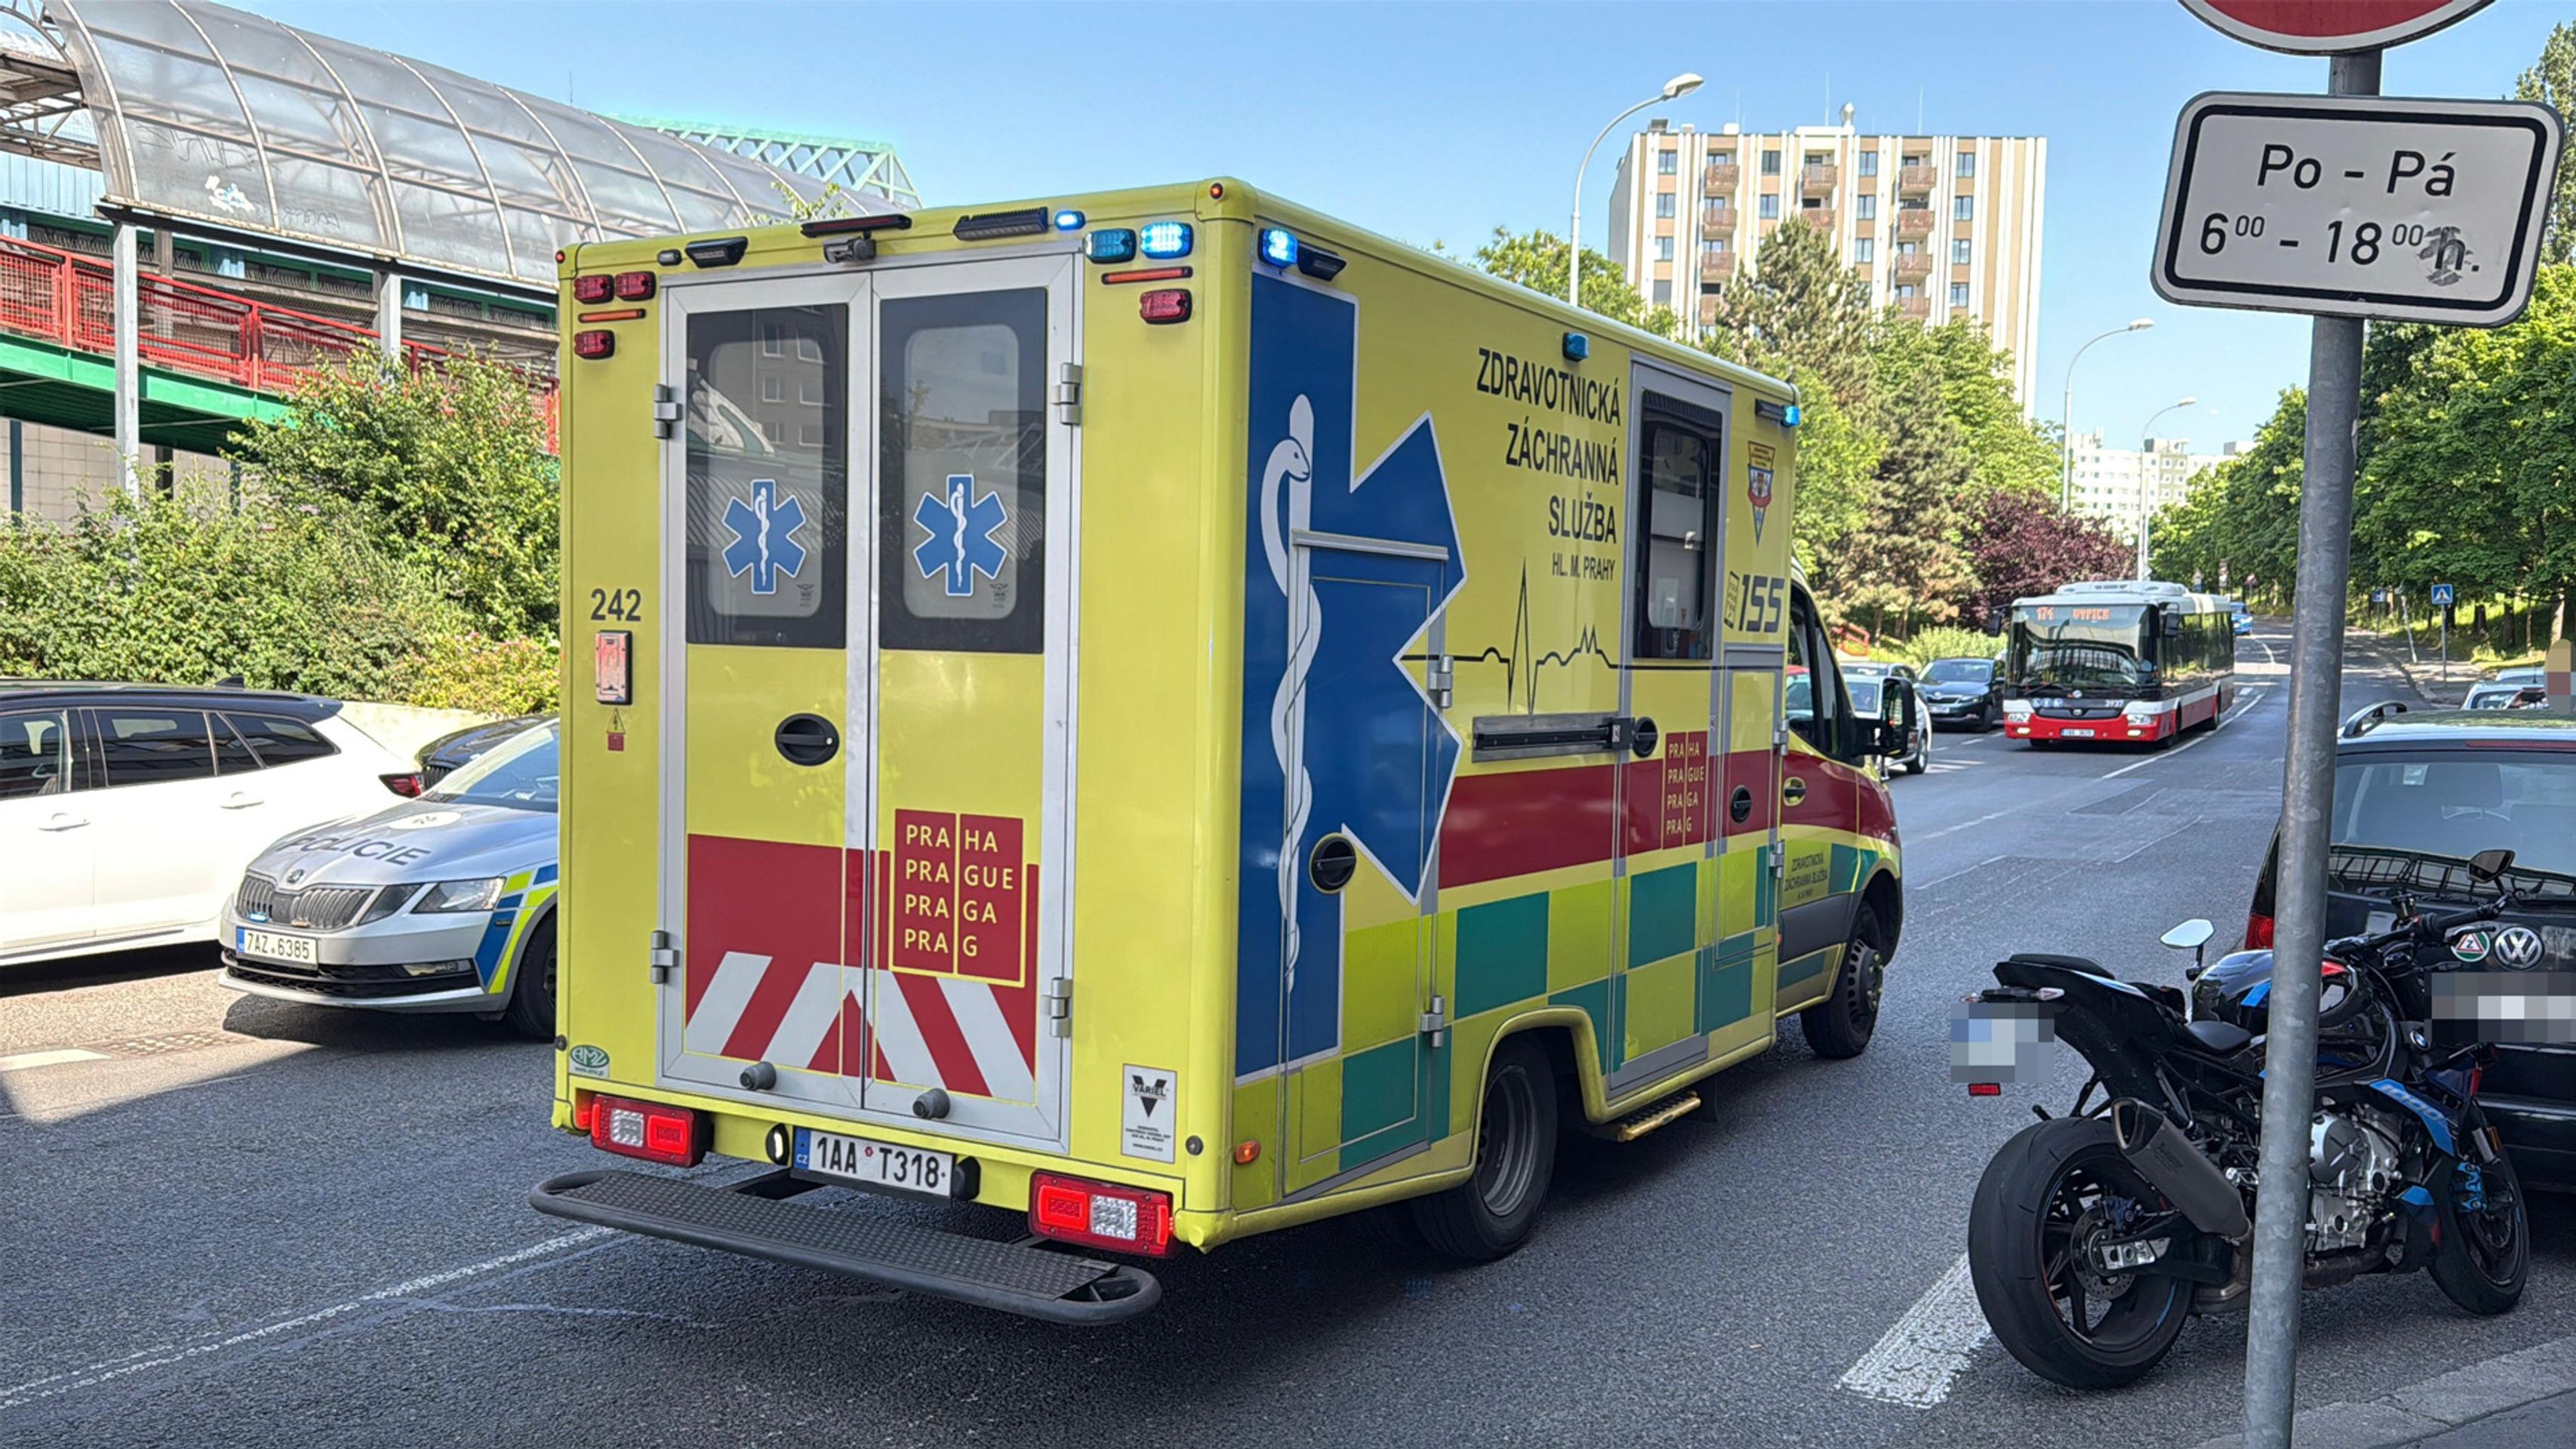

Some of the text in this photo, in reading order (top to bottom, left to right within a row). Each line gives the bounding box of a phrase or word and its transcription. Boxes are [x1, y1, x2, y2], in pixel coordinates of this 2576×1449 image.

[2257, 143, 2322, 189] Po
[2387, 150, 2457, 197] Pá
[1476, 347, 1621, 427] ZDRAVOTNICKÁ
[1505, 416, 1619, 486] ZÁCHRANNÁ
[1548, 491, 1617, 544] SLUŽBA
[1583, 556, 1616, 582] PRAHY
[590, 588, 642, 622] 242
[1738, 574, 1785, 632] 155
[275, 836, 432, 866] POLICIE
[246, 930, 310, 960] 7AZ 6385
[1132, 1083, 1166, 1097] VARIEL
[796, 1136, 940, 1189] CZ 1AA T318
